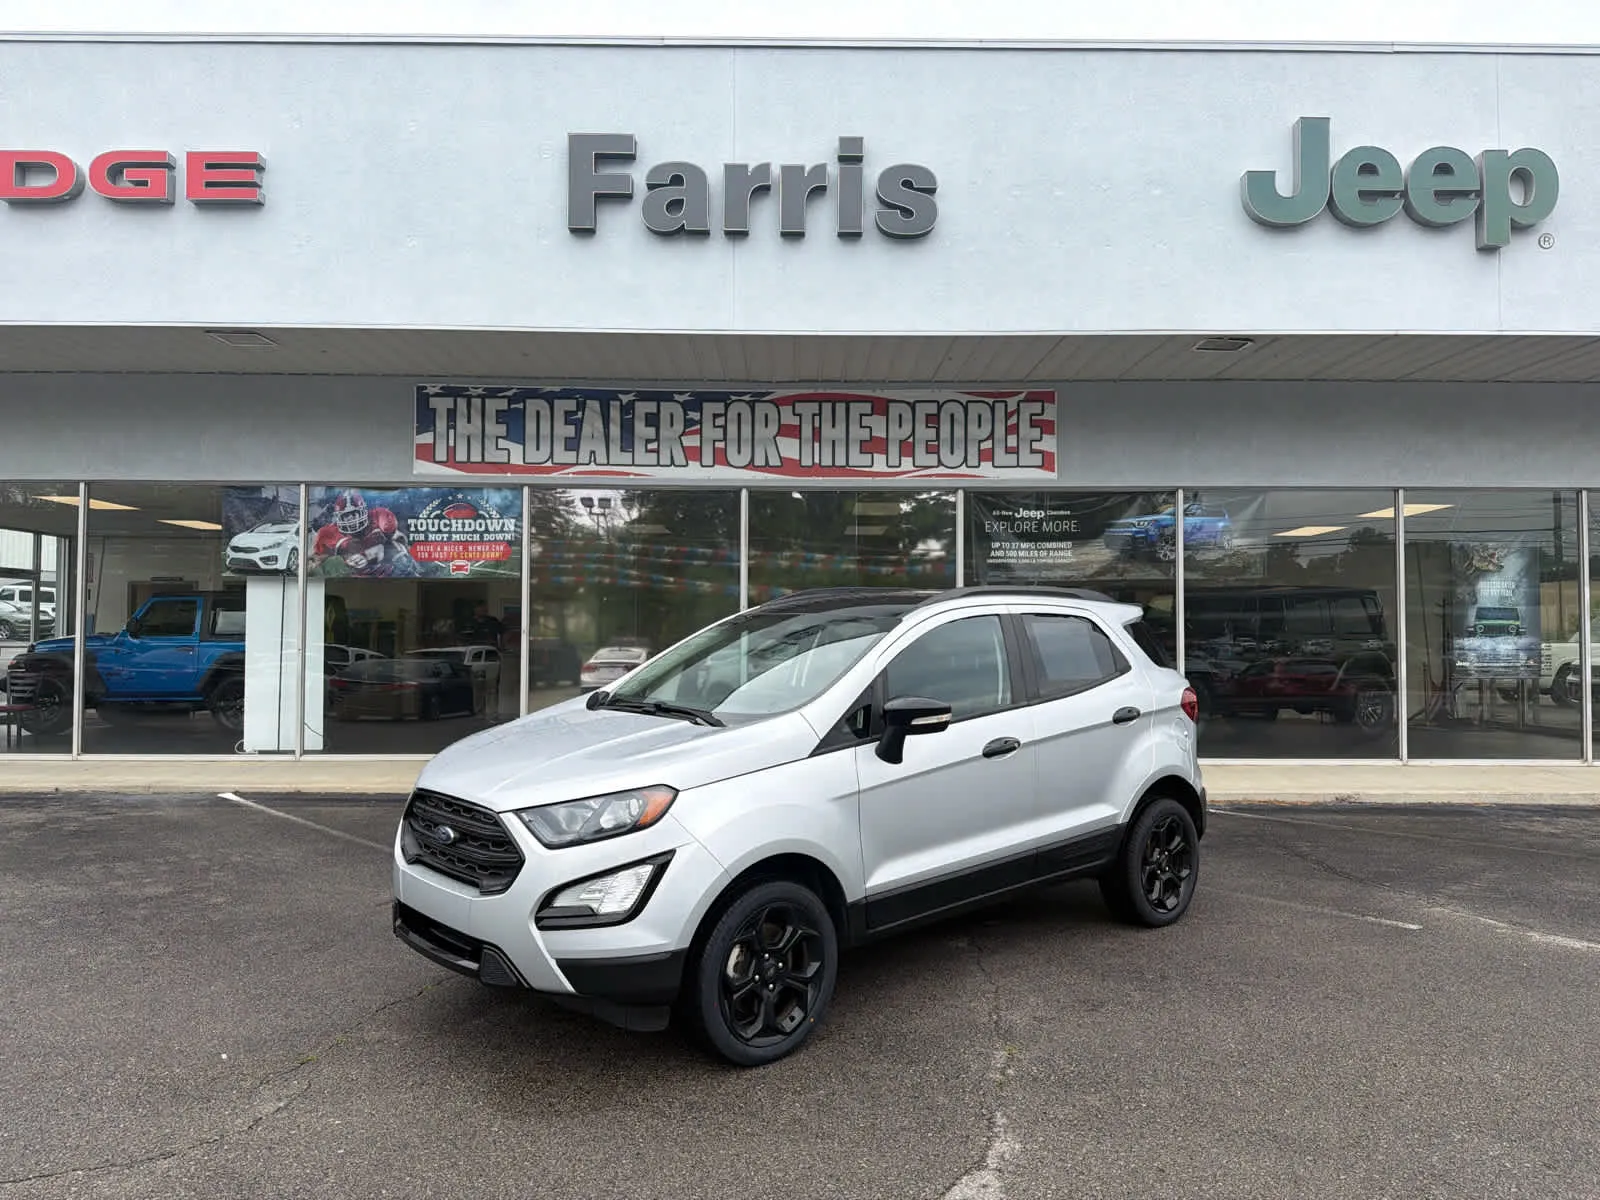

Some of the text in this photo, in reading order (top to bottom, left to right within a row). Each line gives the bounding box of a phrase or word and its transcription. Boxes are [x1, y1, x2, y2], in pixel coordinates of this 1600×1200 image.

[568, 132, 939, 239] Farris
[1240, 117, 1559, 251] Jeep
[428, 396, 1045, 469] THE DEALER FOR THE PEOPLE
[1014, 507, 1046, 520] Jeep
[407, 518, 517, 532] TOUCHDOWN
[985, 520, 1039, 533] EXPLORE
[408, 533, 515, 541] FOR NOT MUCH DOWN!
[991, 541, 1001, 549] UP
[1001, 541, 1010, 549] TO
[1020, 541, 1036, 549] MPG
[1036, 541, 1073, 549] COMBINED
